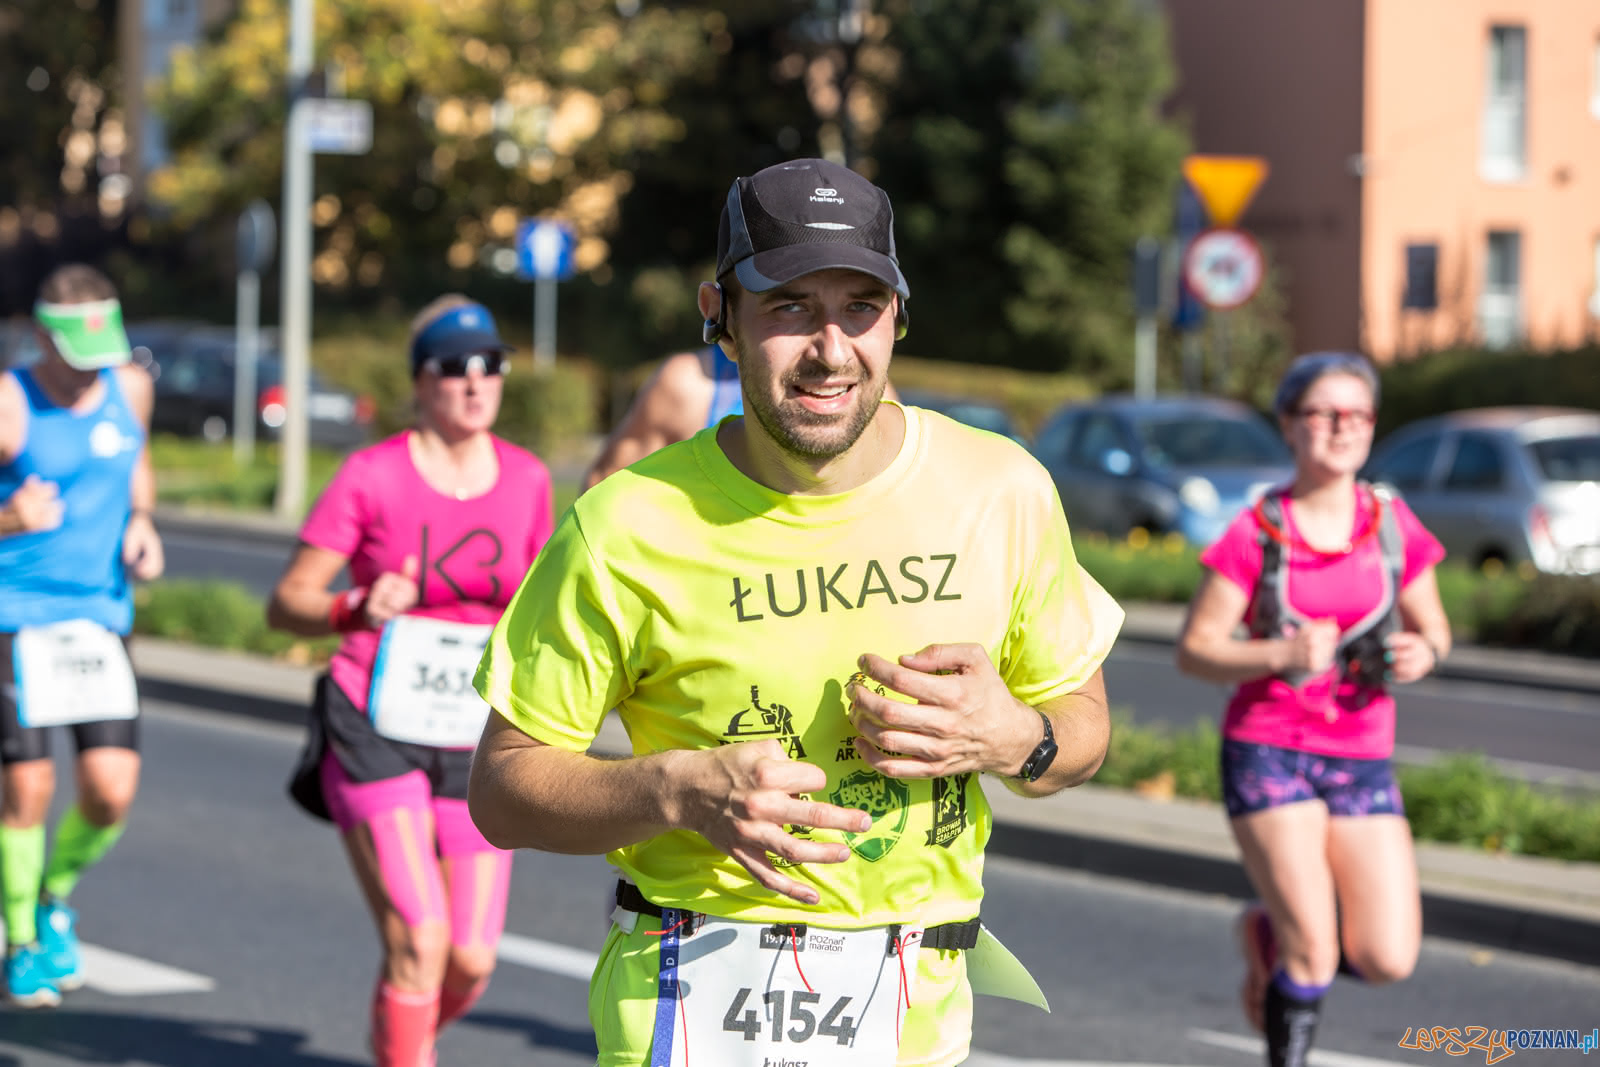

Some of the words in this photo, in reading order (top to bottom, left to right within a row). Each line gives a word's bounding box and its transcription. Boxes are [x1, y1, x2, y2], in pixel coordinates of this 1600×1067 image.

[809, 195, 845, 205] Kalenji
[729, 553, 962, 622] ŁUKASZ
[411, 662, 474, 696] 363
[839, 778, 886, 805] BREW
[808, 943, 843, 952] maraton
[722, 987, 857, 1046] 4154
